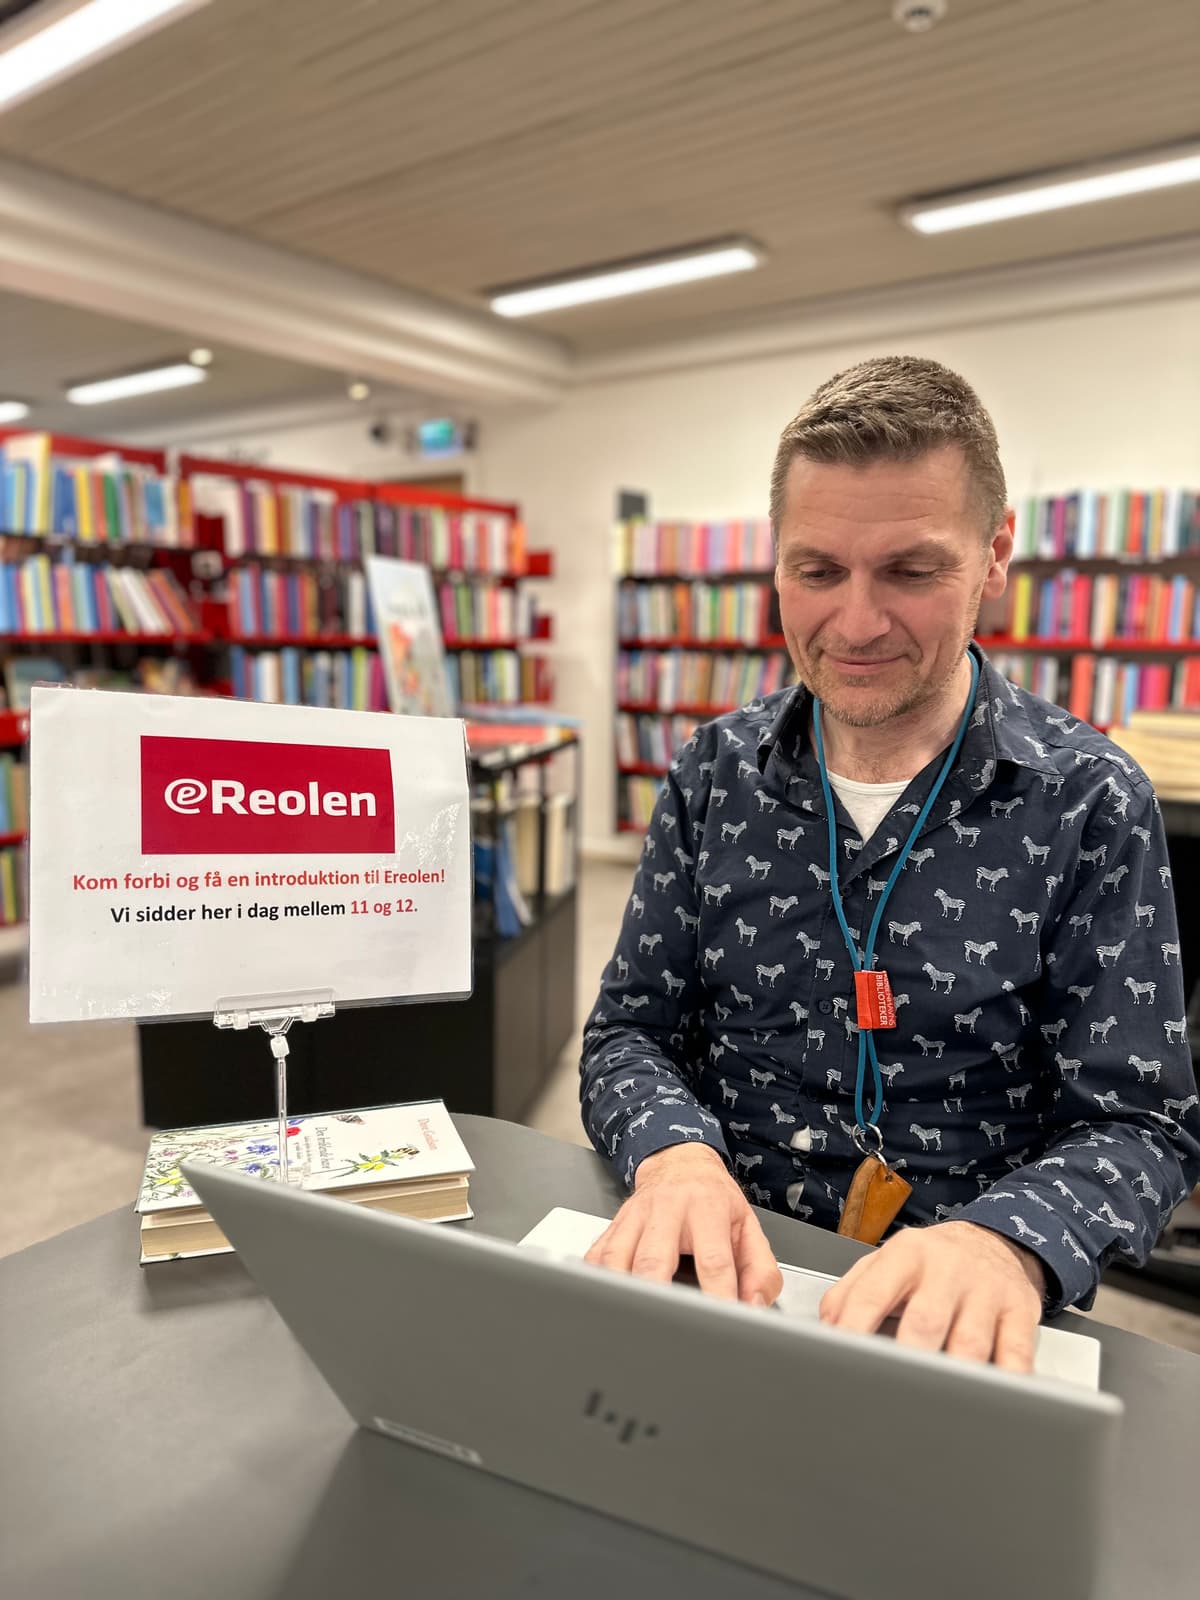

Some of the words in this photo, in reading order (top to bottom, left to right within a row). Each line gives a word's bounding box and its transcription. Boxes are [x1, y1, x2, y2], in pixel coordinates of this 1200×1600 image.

[73, 874, 118, 891] Kom
[123, 872, 170, 890] forbi
[176, 876, 199, 892] og
[204, 871, 222, 888] få
[227, 875, 250, 887] en
[255, 870, 360, 887] introduktion
[364, 869, 380, 885] til
[384, 868, 446, 884] Ereolen!
[110, 906, 130, 923] Vi
[136, 904, 197, 923] sidder
[201, 904, 233, 920] her
[237, 903, 242, 919] i
[247, 902, 280, 921] dag
[284, 900, 346, 917] mellem
[351, 900, 369, 915] 11
[373, 902, 392, 917] og
[396, 898, 418, 914] 12.
[876, 974, 888, 1026] BIBLIOTEKER
